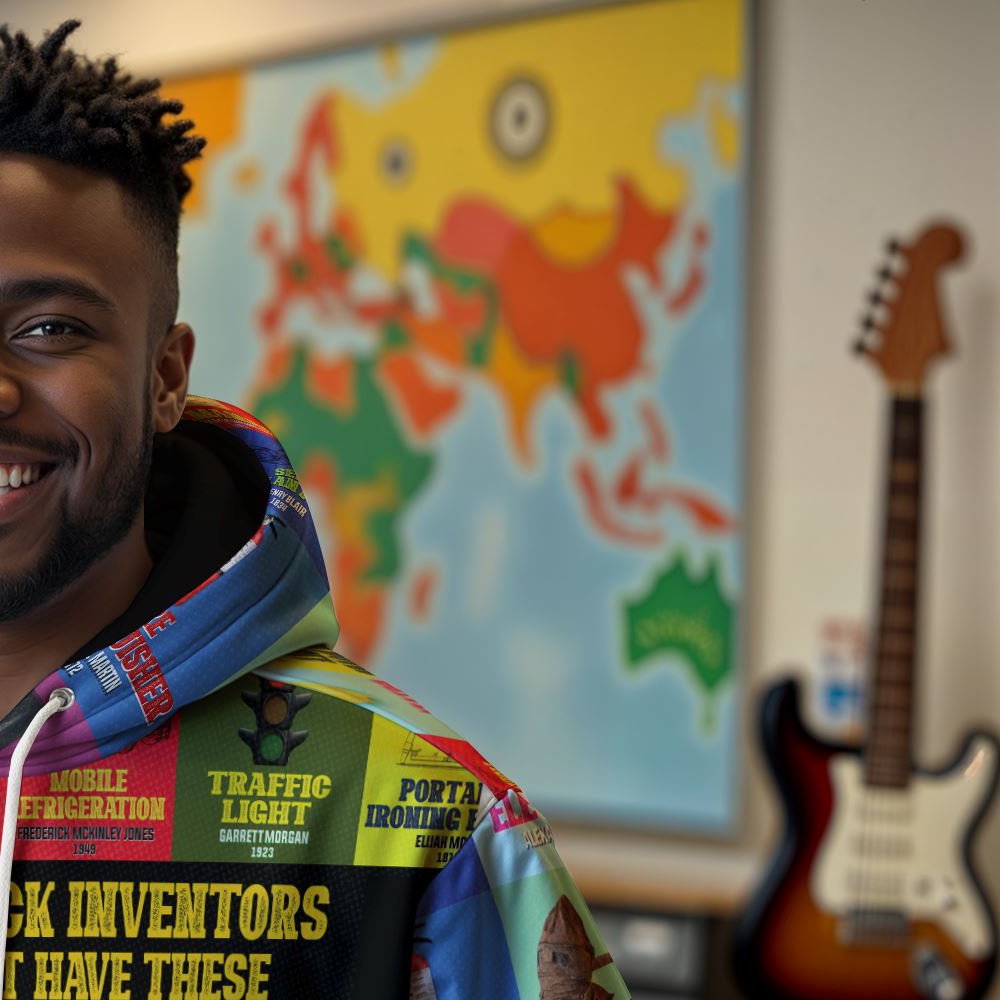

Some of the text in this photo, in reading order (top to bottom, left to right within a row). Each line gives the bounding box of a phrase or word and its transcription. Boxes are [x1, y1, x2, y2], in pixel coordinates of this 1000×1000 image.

[88, 651, 122, 694] MARTIN
[49, 768, 128, 793] MOBILE
[207, 770, 332, 799] TRAFFIC
[18, 795, 165, 821] EFRIGERATION
[220, 800, 312, 826] LIGHT
[365, 803, 461, 830] IRONING
[17, 826, 155, 841] FREDERICK MCKINLEY JONES
[415, 835, 448, 850] ELIJAH
[72, 843, 96, 855] 1949
[250, 846, 274, 858] 1923
[66, 881, 330, 941] INVENTORS
[33, 951, 133, 1000] HAVE
